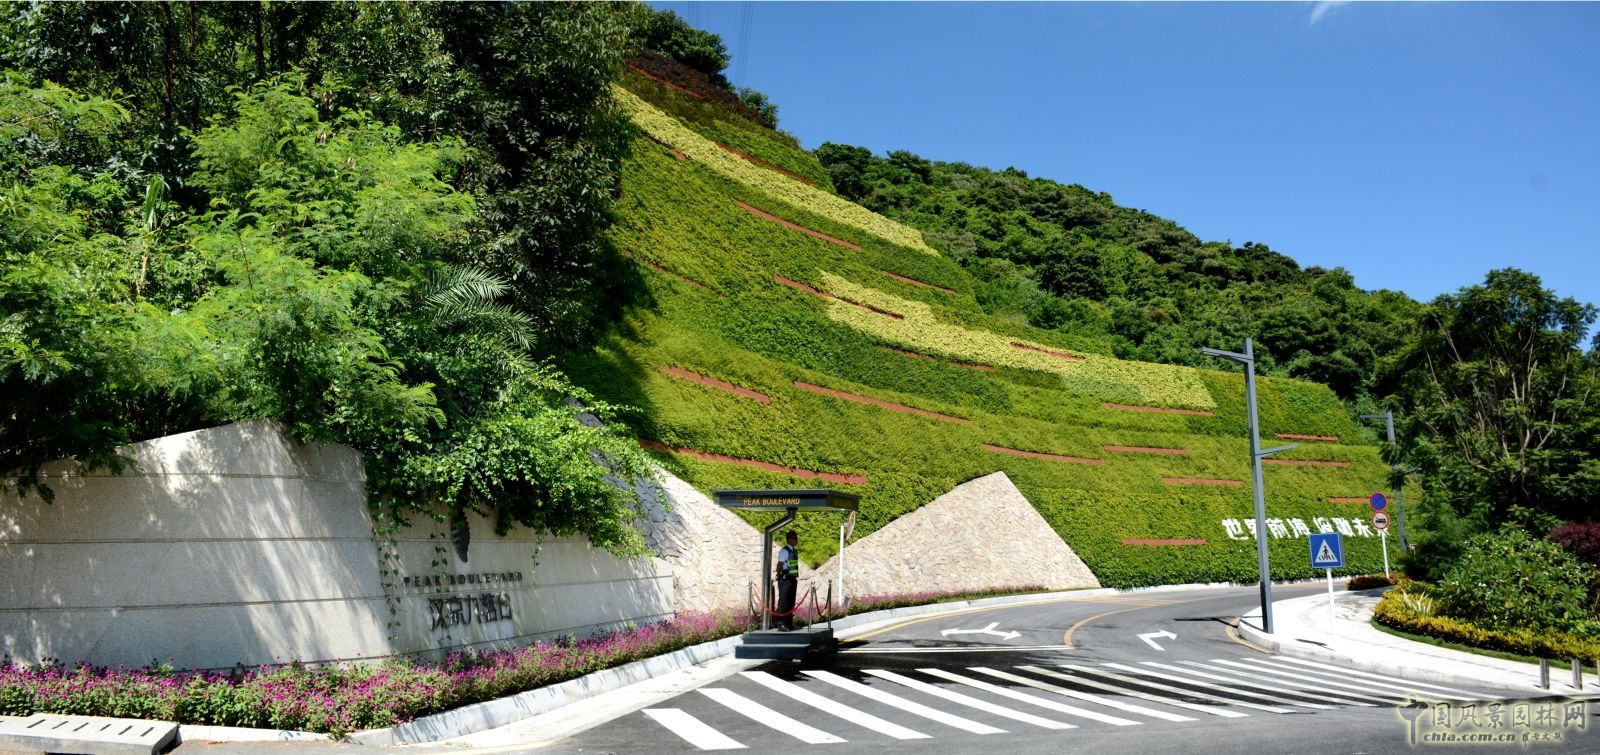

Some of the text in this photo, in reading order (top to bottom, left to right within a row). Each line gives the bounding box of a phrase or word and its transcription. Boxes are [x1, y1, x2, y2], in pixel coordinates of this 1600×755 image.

[743, 497, 800, 506] PEAK BOULEVARD
[404, 571, 523, 587] PEAK BOULEVARD
